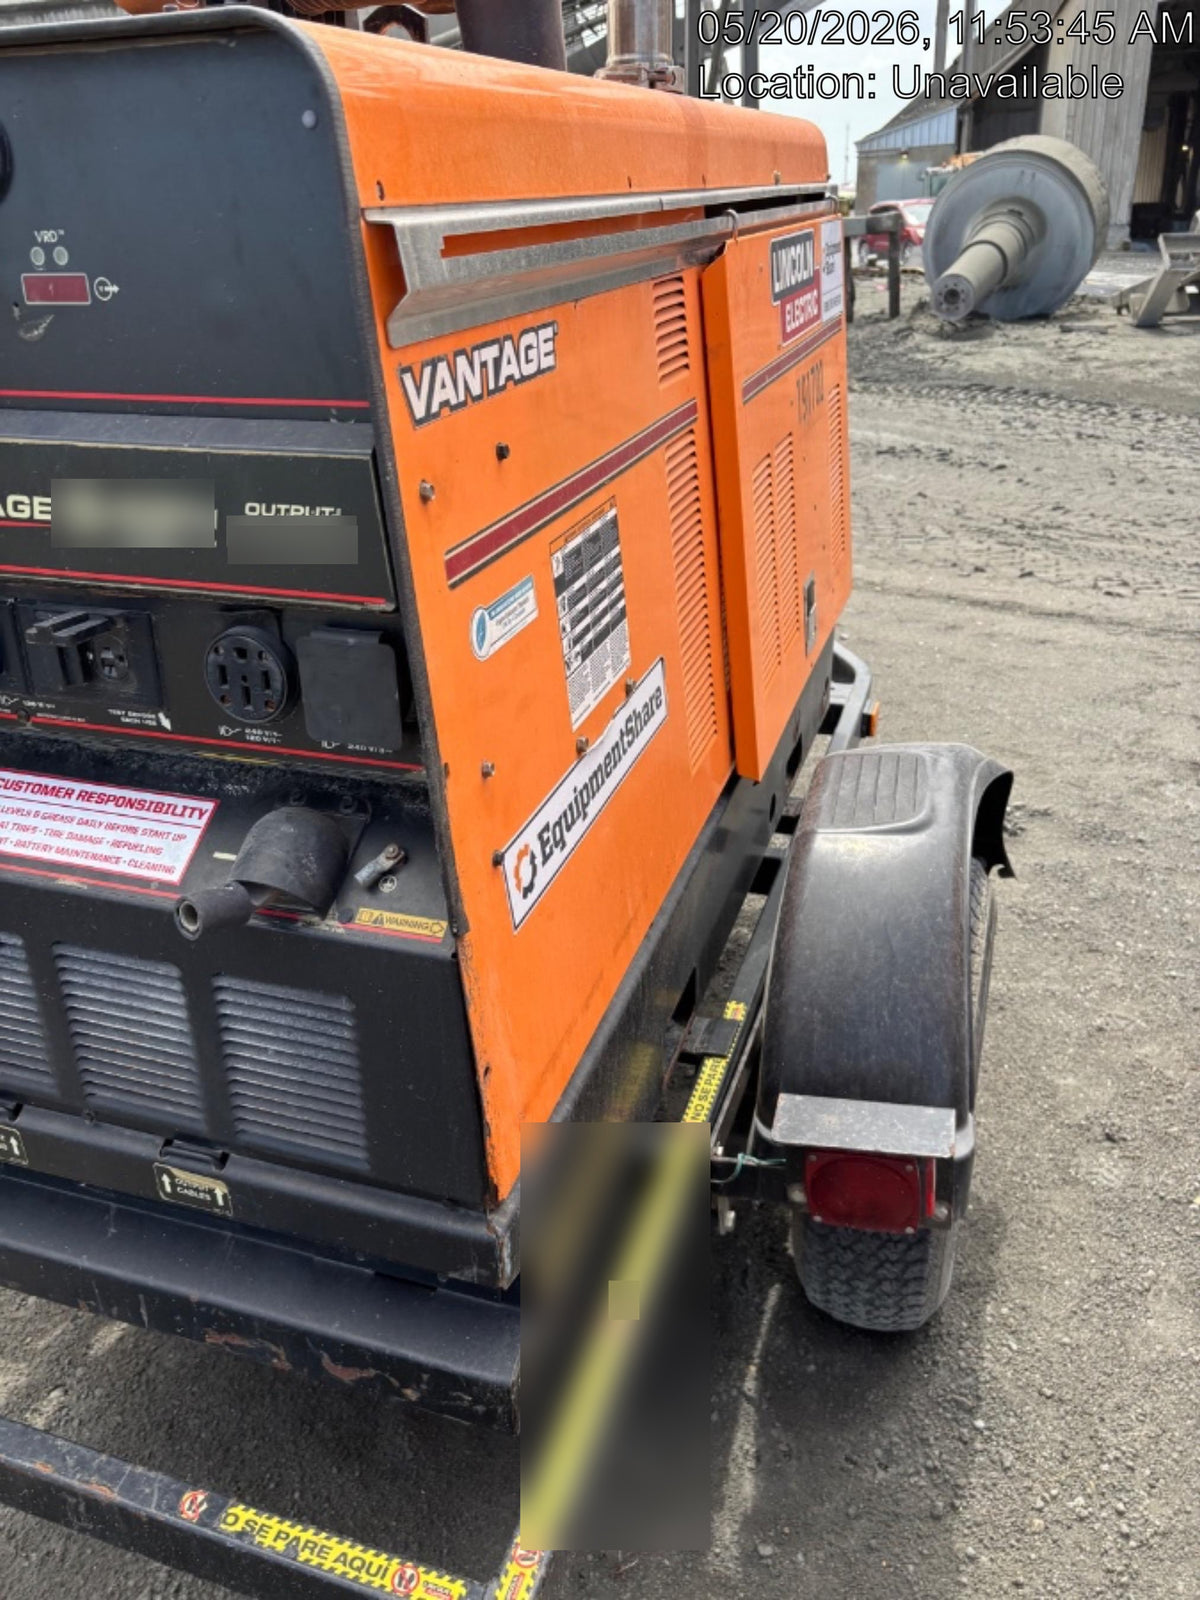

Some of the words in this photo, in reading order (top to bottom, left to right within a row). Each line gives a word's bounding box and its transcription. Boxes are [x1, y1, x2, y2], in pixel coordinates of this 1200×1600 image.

[772, 239, 813, 293] LINCOLN
[785, 289, 819, 333] ELECTRIC
[400, 324, 556, 424] VANTAGE
[536, 685, 663, 868] EquipmentShare
[76, 790, 209, 820] RESPONSIBILITY
[140, 828, 172, 841] START
[127, 859, 177, 876] CLEANING
[385, 915, 429, 930] WARNING
[243, 1518, 273, 1539] SE
[273, 1530, 334, 1560] PARE
